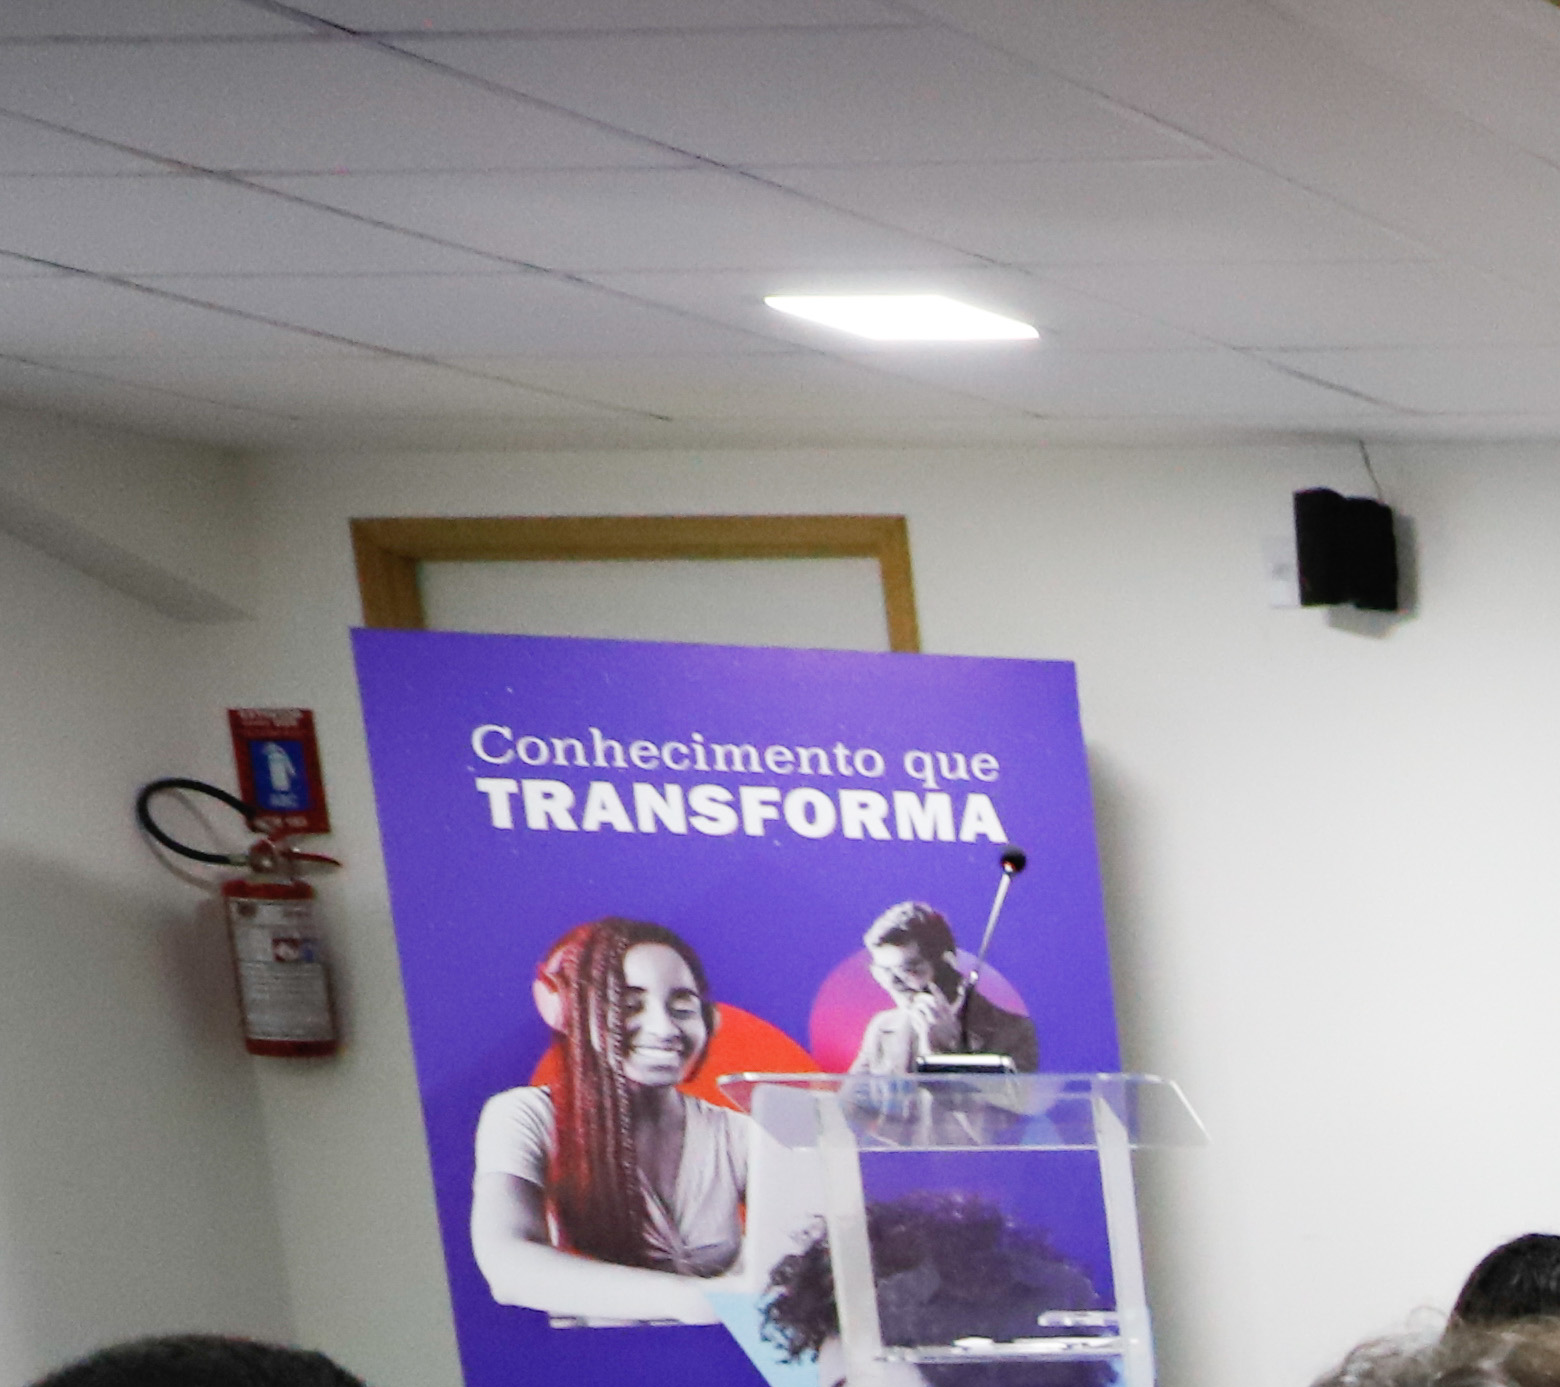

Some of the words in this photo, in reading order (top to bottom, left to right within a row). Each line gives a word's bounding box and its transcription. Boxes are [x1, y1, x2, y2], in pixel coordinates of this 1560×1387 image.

[471, 724, 885, 778] Conhecimento
[904, 748, 1000, 790] que
[475, 777, 1009, 844] TRANSFORMA
